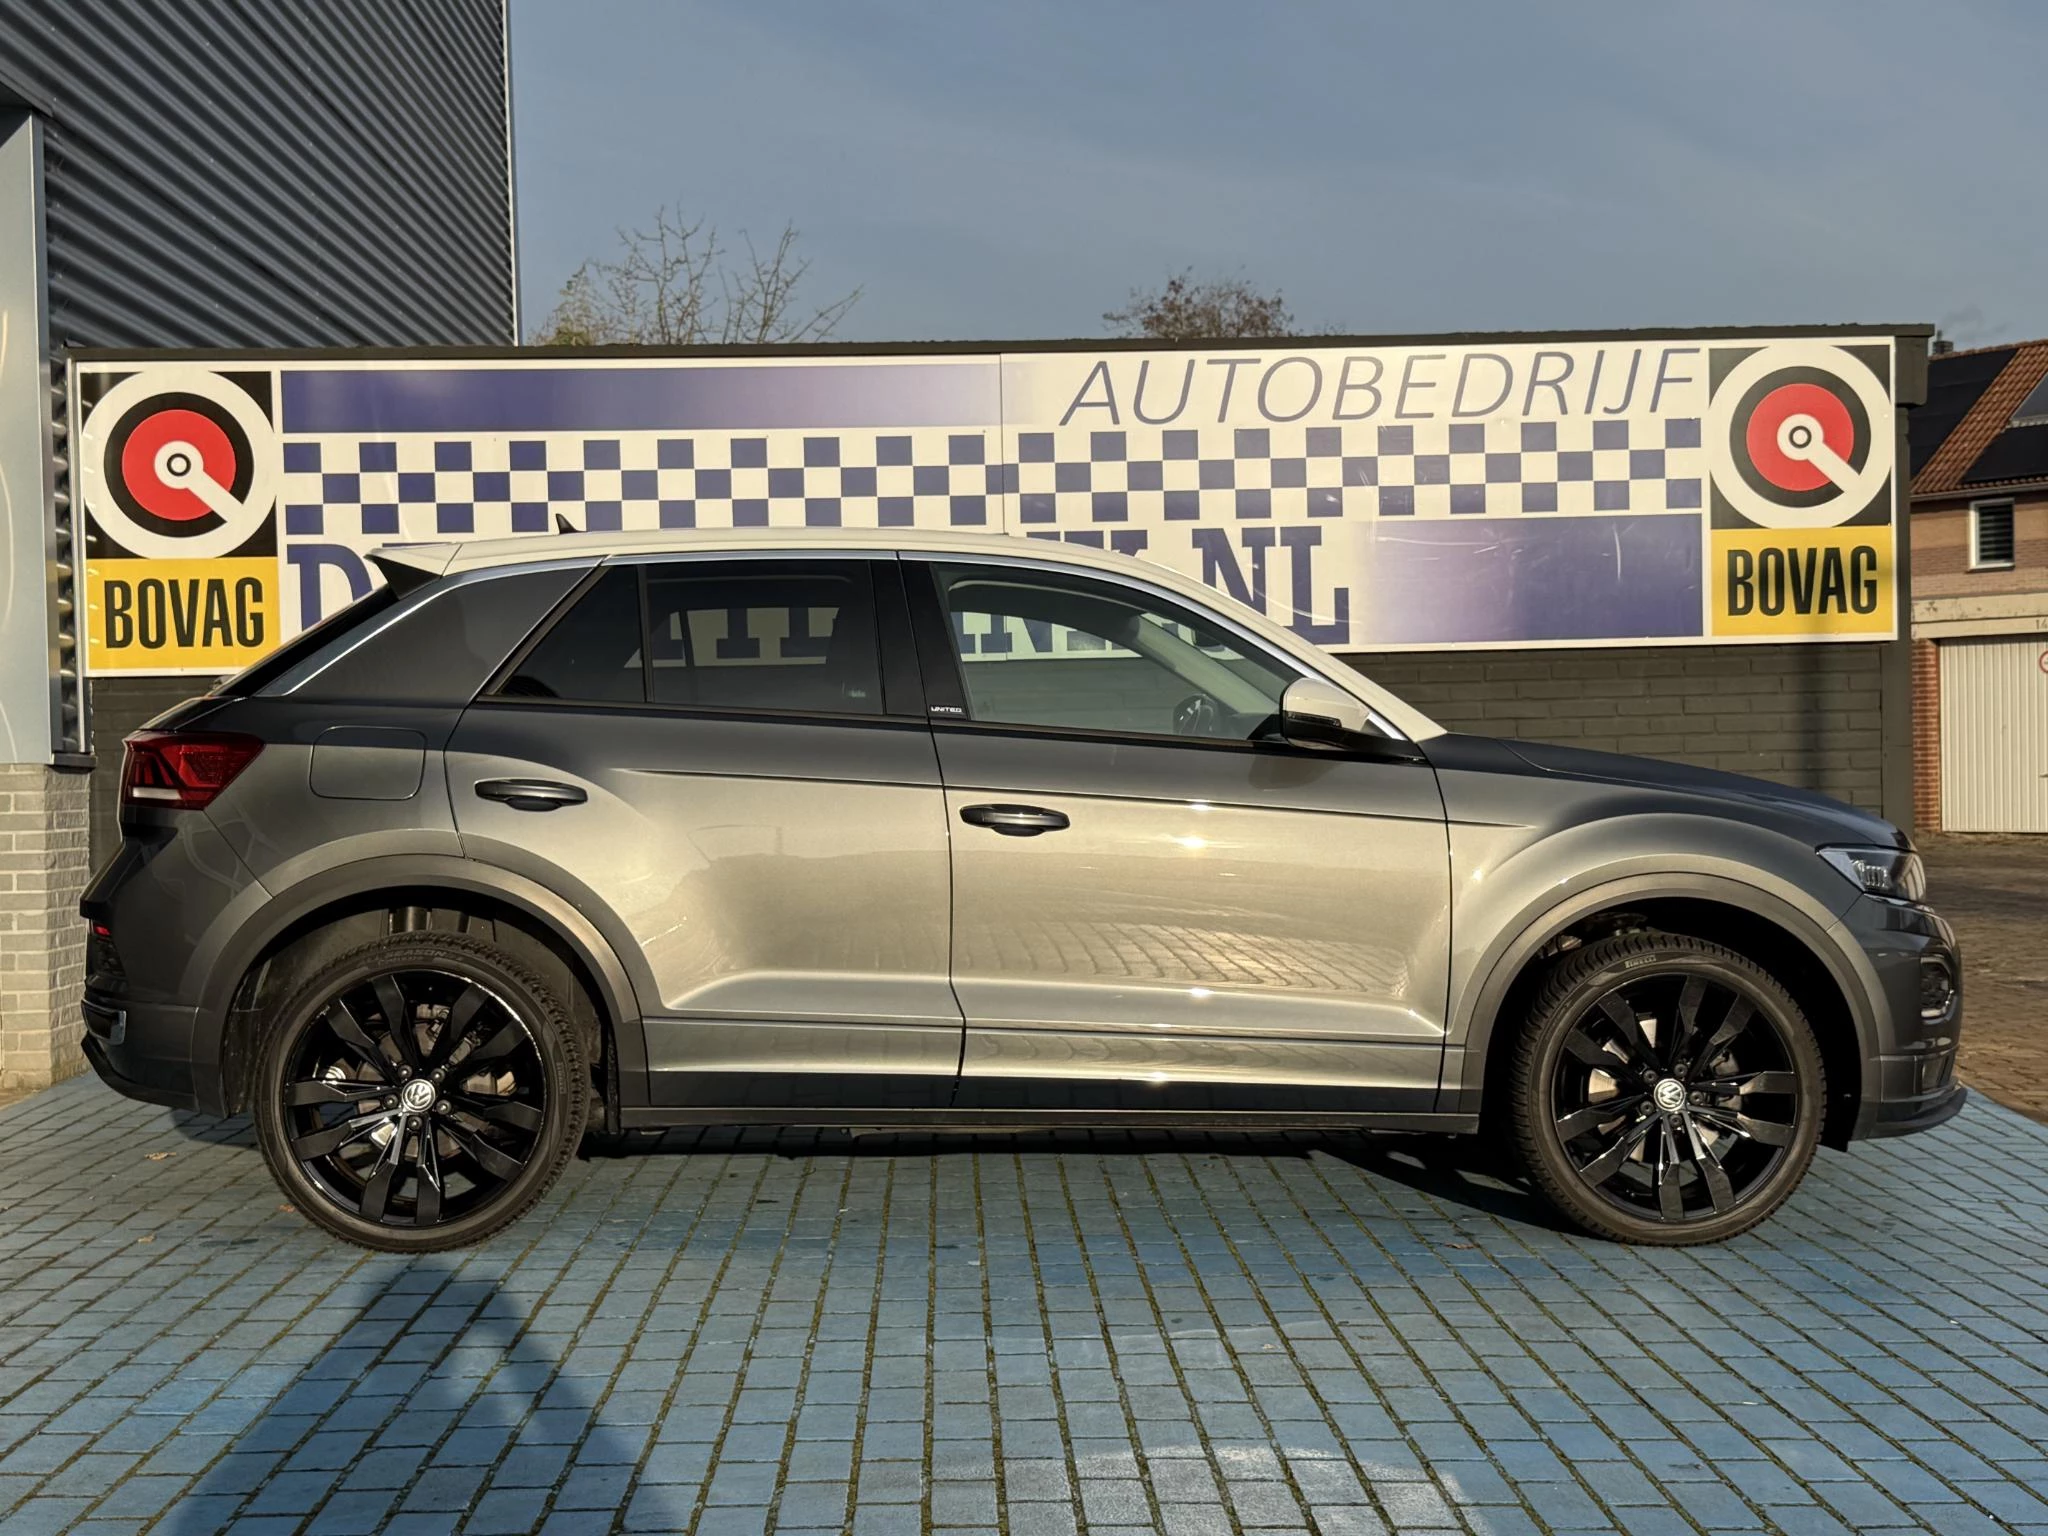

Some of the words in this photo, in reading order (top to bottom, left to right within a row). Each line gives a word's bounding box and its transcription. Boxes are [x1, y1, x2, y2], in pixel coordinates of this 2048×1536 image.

[1060, 348, 1700, 426] AUTOBEDRIJF
[104, 577, 264, 649] BOVAG
[1728, 546, 1877, 616] BOVAG
